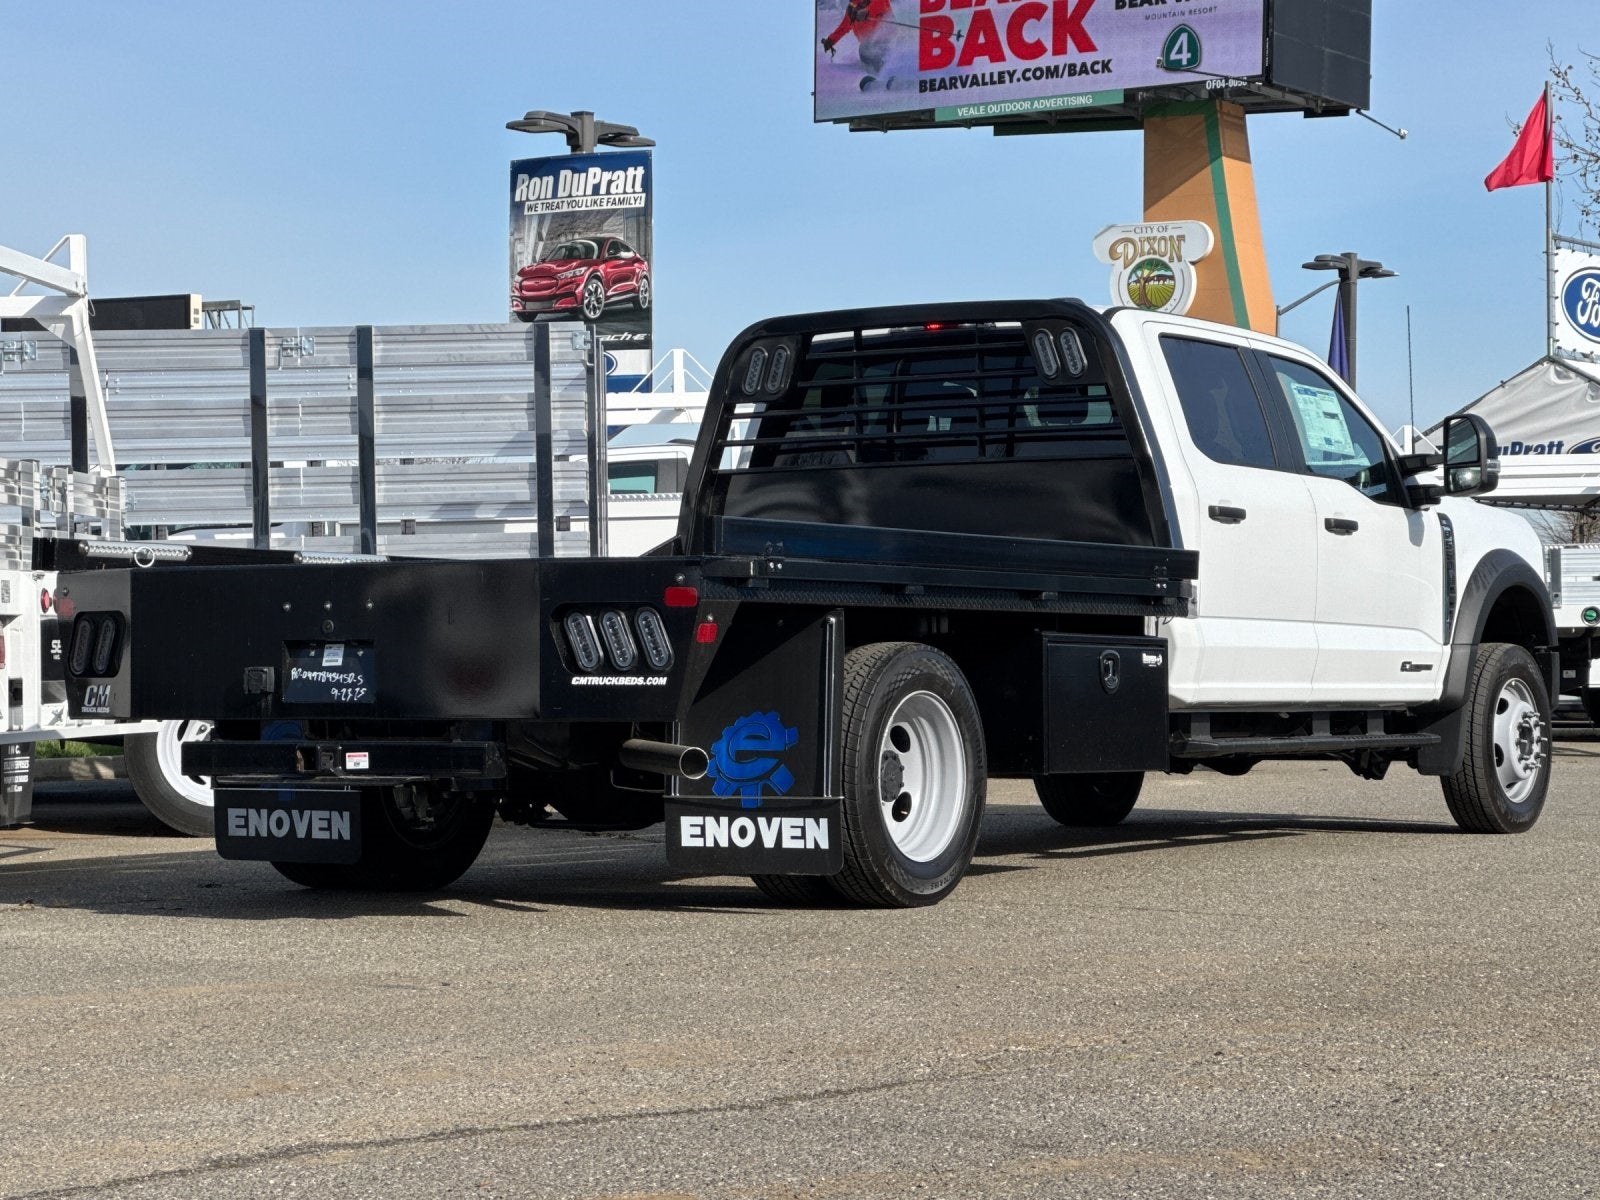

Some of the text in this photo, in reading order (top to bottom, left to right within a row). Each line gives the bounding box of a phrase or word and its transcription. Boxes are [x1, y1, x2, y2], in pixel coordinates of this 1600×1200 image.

[1145, 6, 1218, 21] MOUNTAIN RESORT
[919, 0, 1098, 71] BACK
[1169, 32, 1192, 66] 4
[918, 59, 1113, 93] BEARVALLEY.COM/BACK
[957, 95, 1093, 117] VEALE OUTDOOR ADVERTISING
[515, 166, 645, 202] Ron DuPratt
[527, 195, 643, 213] WE TREAT YOU LIKE FAMILY!
[1133, 225, 1169, 234] CITY OF
[571, 676, 668, 686] CMTRUCKBEDS.COM
[83, 684, 111, 707] CM
[226, 807, 351, 841] ENOVEN
[679, 816, 830, 850] ENOVEN
